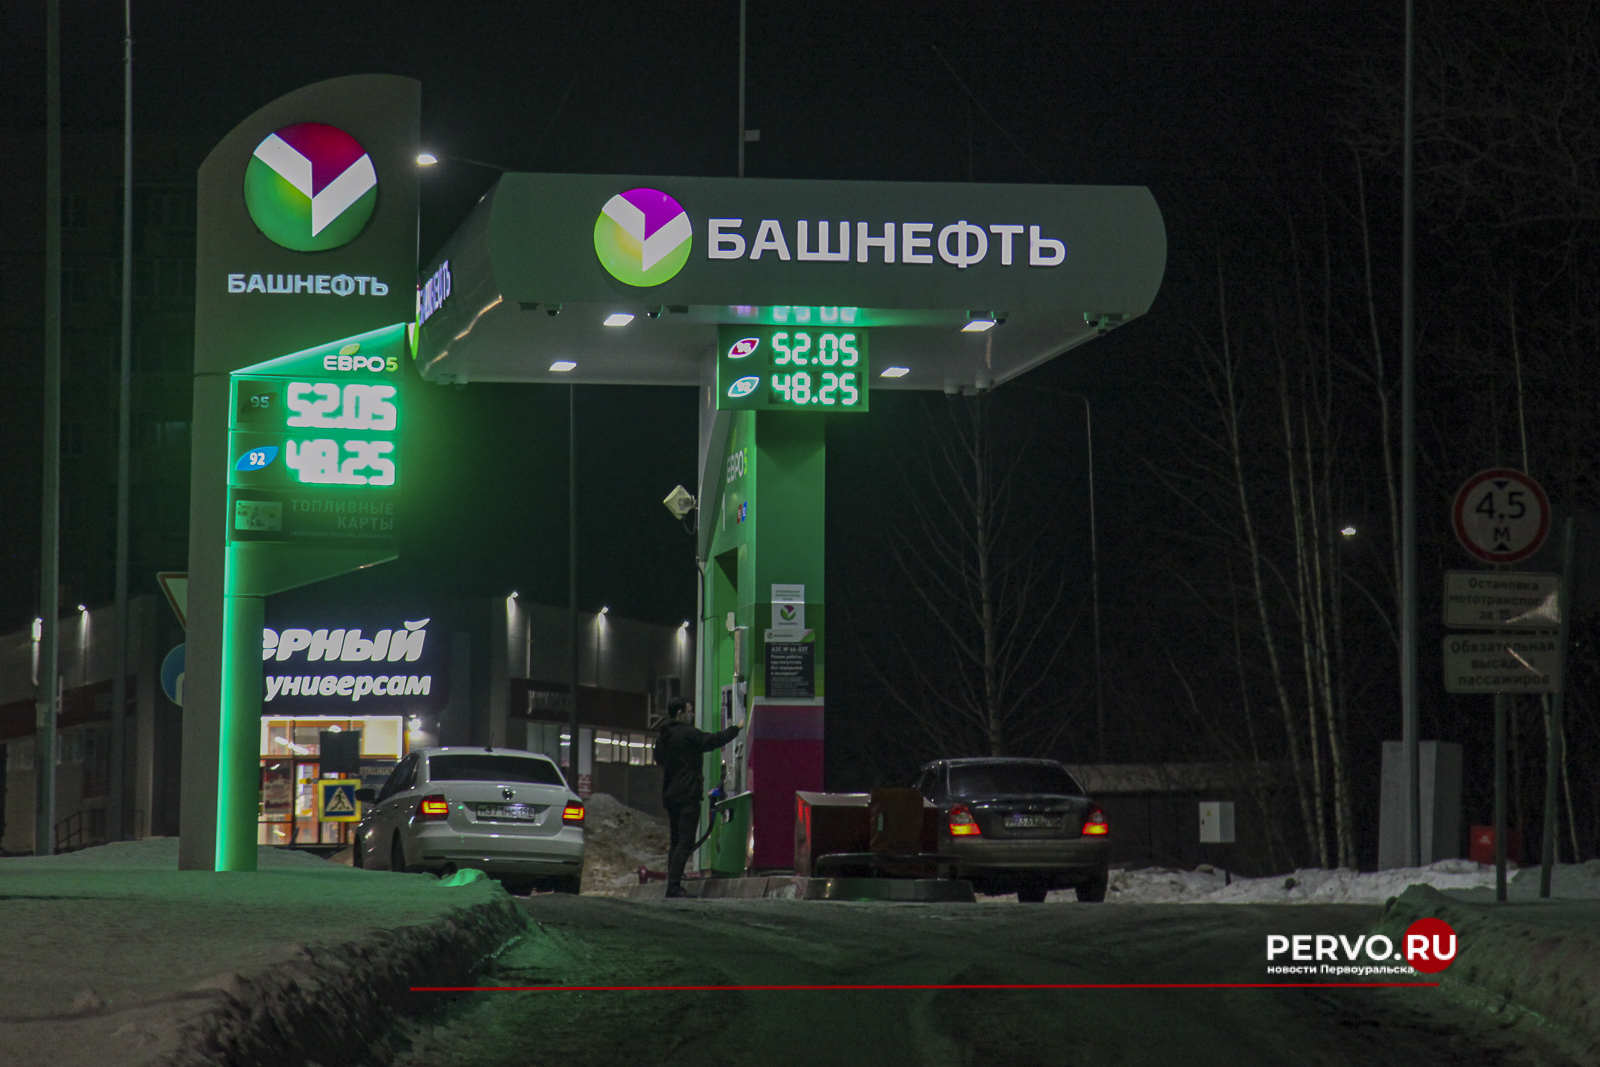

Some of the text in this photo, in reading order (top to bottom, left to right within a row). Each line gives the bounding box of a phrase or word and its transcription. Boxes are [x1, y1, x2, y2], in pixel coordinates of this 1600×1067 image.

[708, 217, 1066, 269] БАШНЕФТЬ
[227, 273, 389, 297] БАШНЕФТЬ
[772, 332, 859, 367] 52.05
[772, 371, 859, 406] 48.25
[250, 395, 270, 409] 95
[249, 451, 266, 466] 92
[291, 499, 394, 516] ТОПЛИВНЫЕ
[1475, 490, 1527, 523] 4,5
[337, 516, 394, 531] КАРТЫ
[1468, 576, 1540, 591] Остановка
[264, 674, 432, 702] универсам
